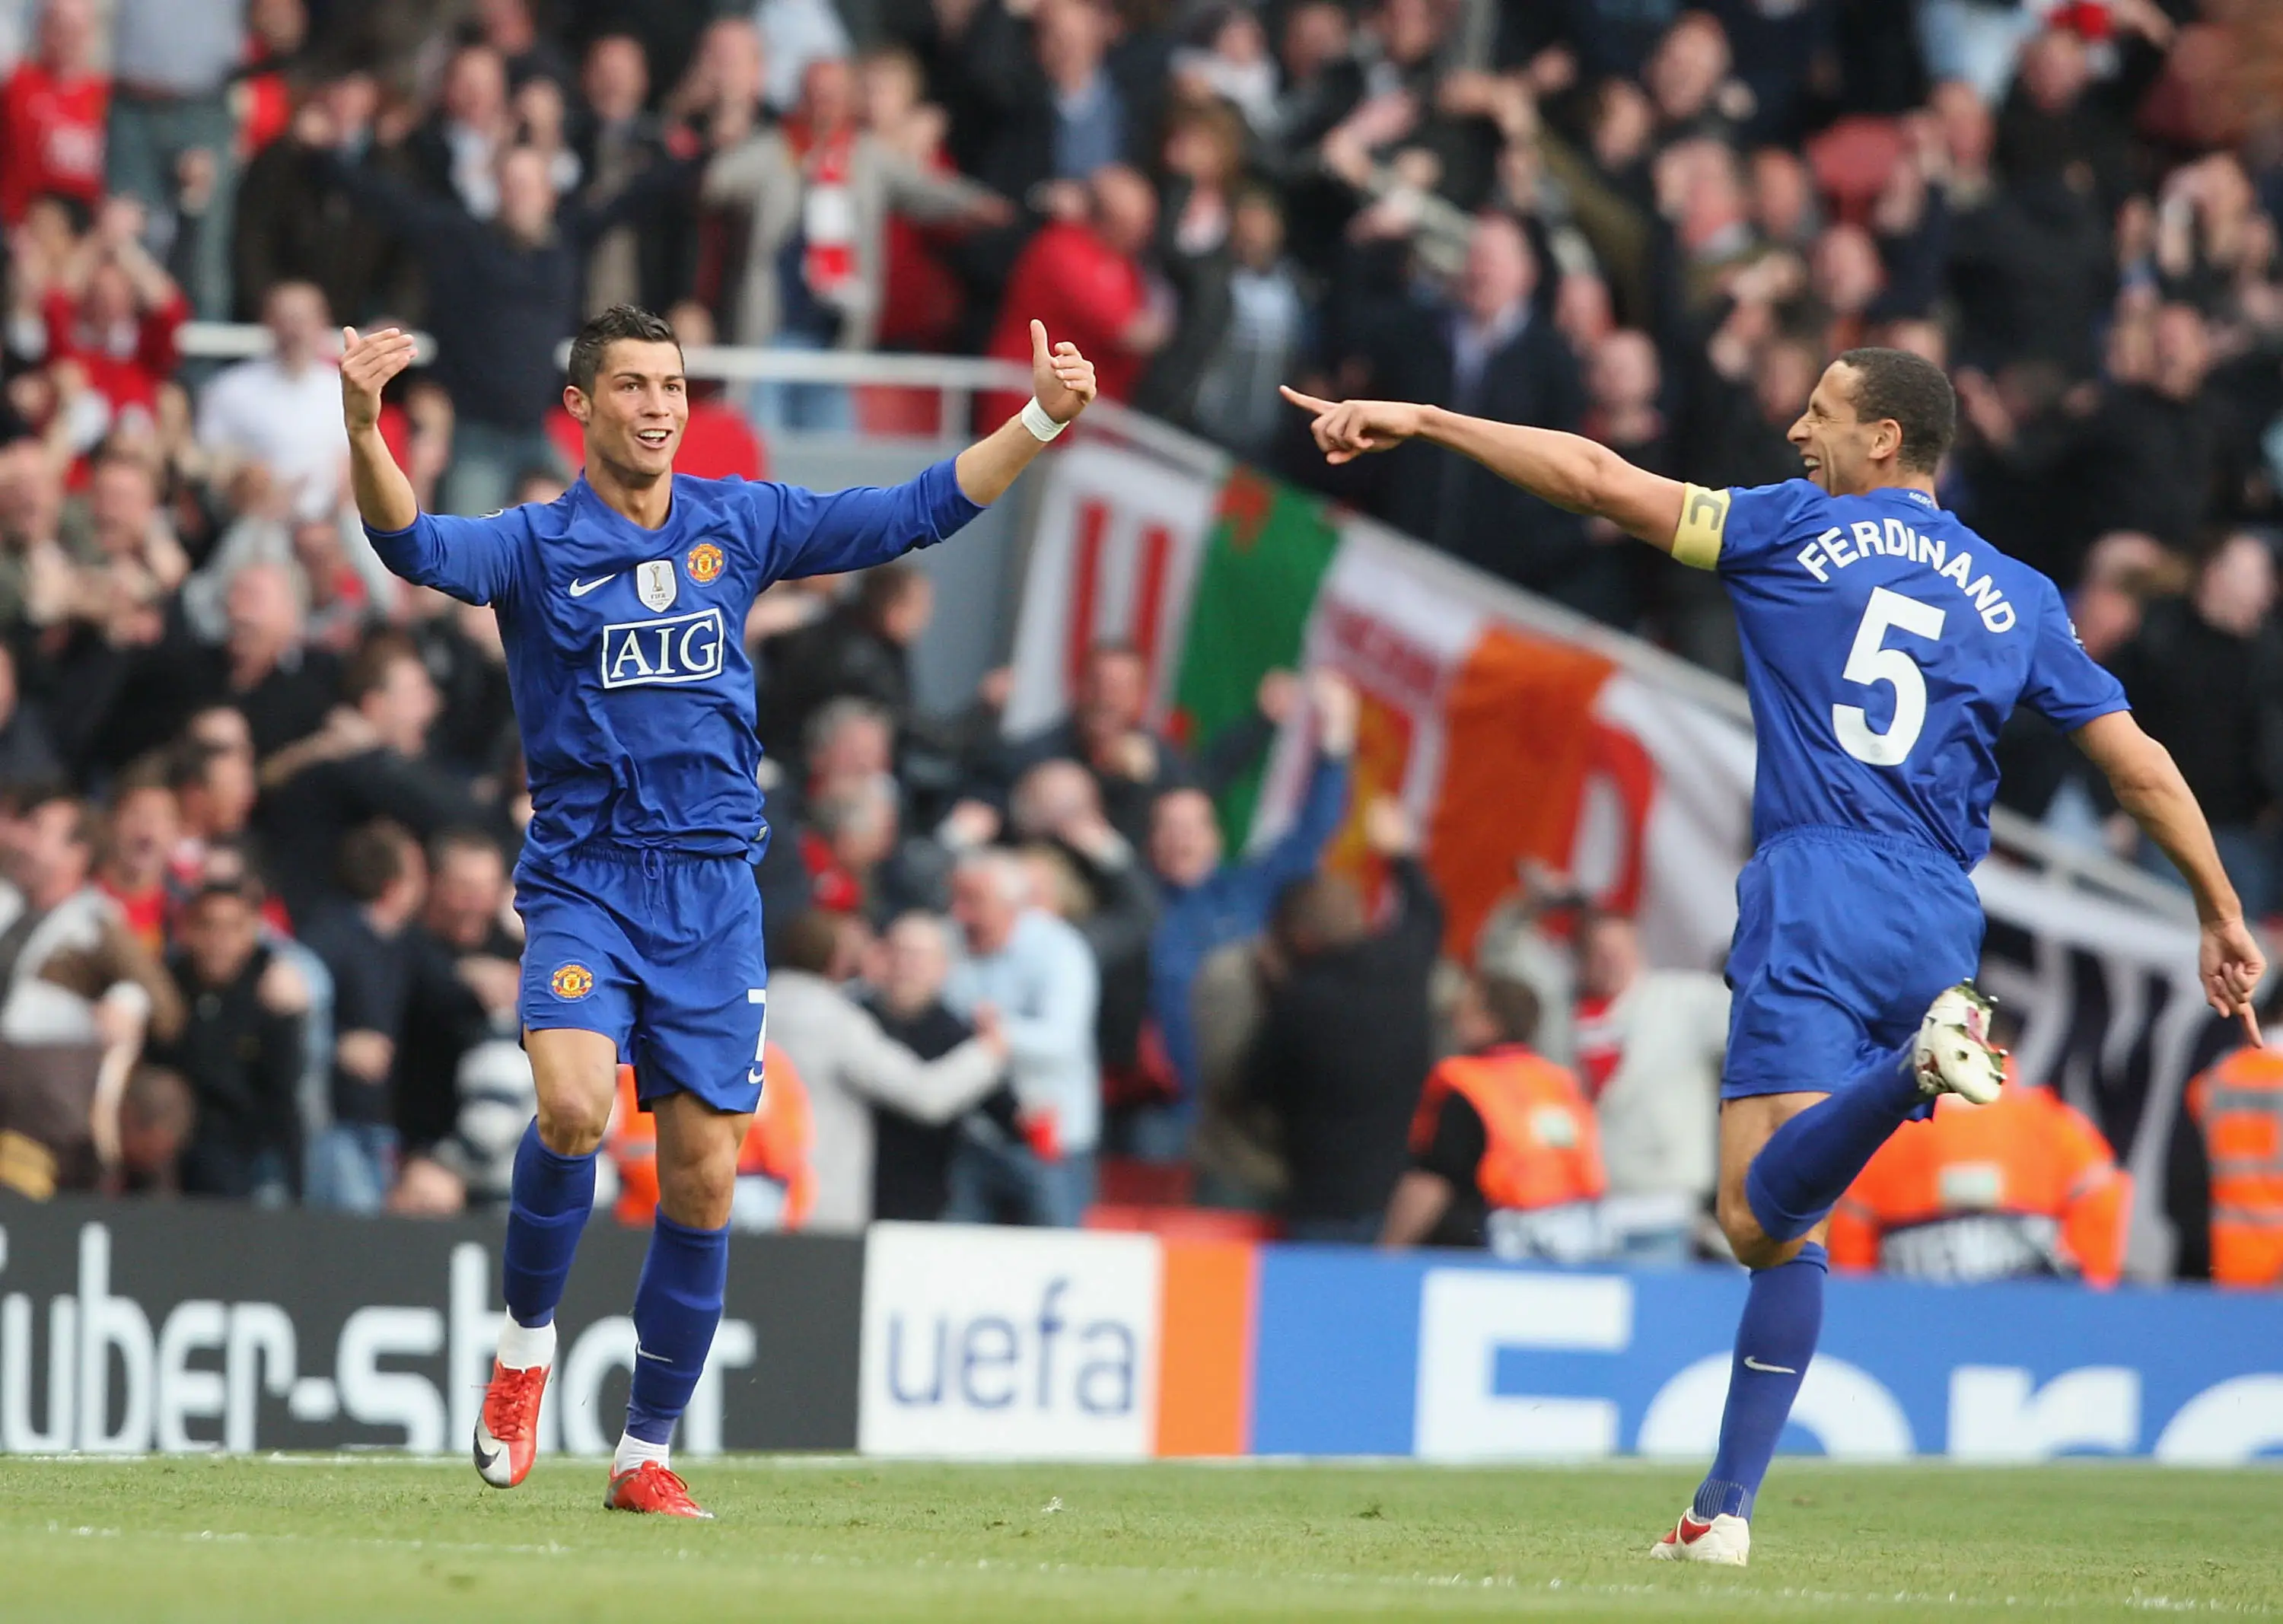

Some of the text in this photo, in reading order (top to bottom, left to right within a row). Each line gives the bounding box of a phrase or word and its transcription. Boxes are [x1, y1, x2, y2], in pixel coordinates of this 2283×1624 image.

[1797, 517, 2016, 633] FERDINAND
[610, 619, 717, 679] AIG
[1832, 586, 1946, 766] 5
[747, 988, 766, 1062] 7
[887, 1272, 1138, 1416] uefa
